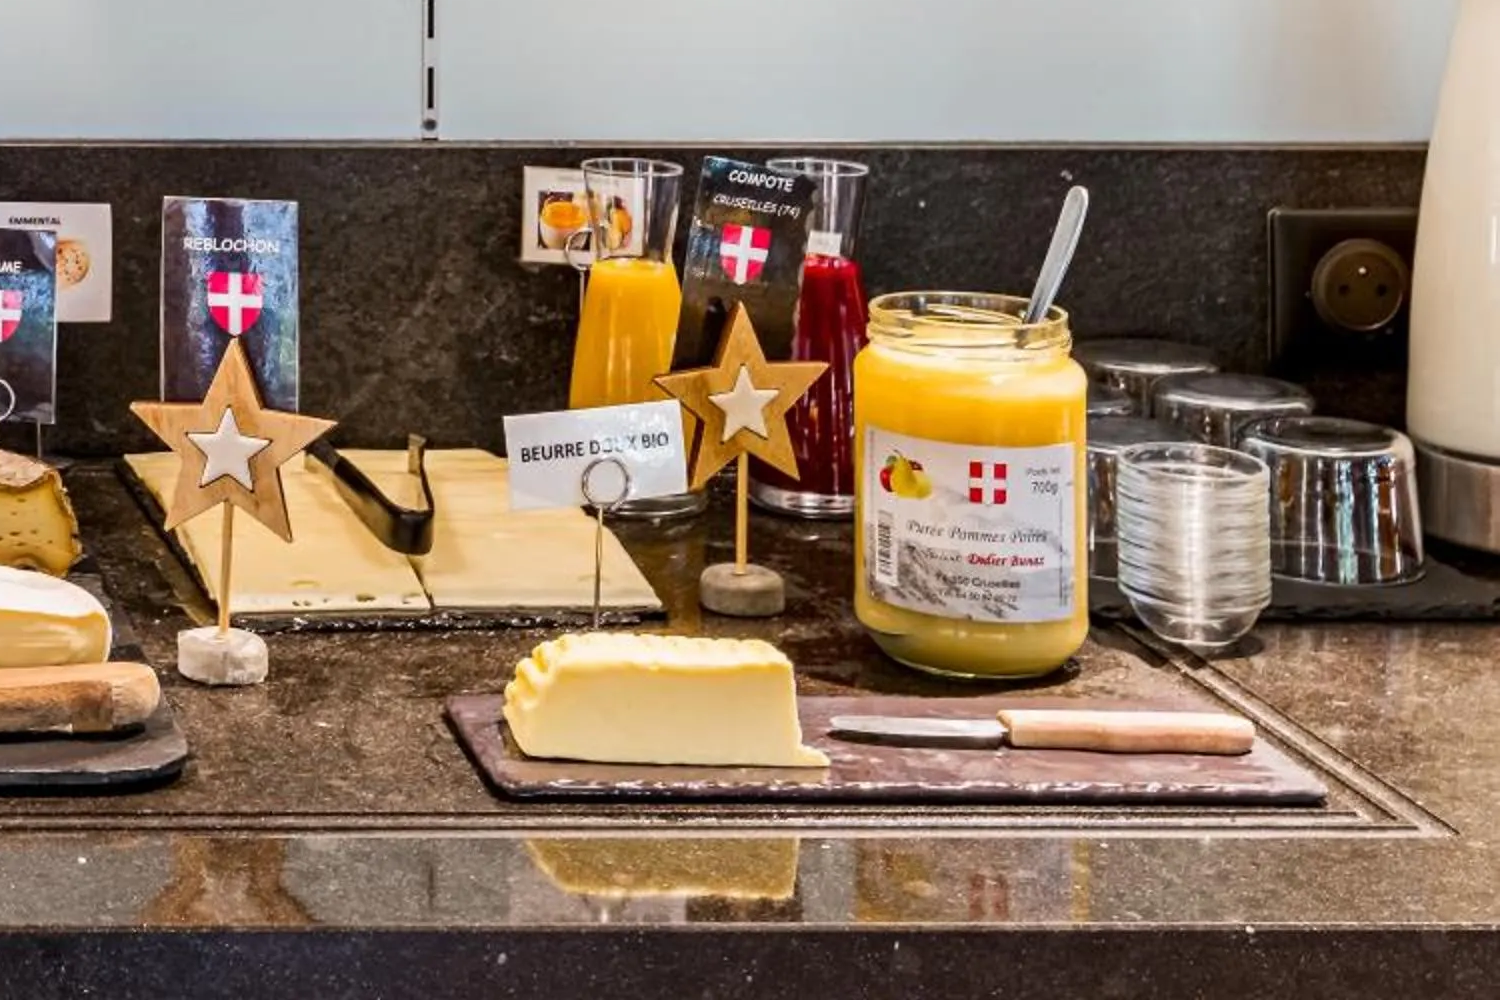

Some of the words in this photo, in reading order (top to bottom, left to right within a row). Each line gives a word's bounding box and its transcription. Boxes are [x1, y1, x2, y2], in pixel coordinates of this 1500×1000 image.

[728, 169, 796, 193] COMPOTE
[777, 203, 801, 220] (74)
[8, 216, 62, 226] EMMENTAL
[182, 237, 281, 255] REBLOCHON
[520, 440, 585, 463] BEURRE
[641, 431, 670, 449] BIO
[948, 525, 1006, 543] Pommes
